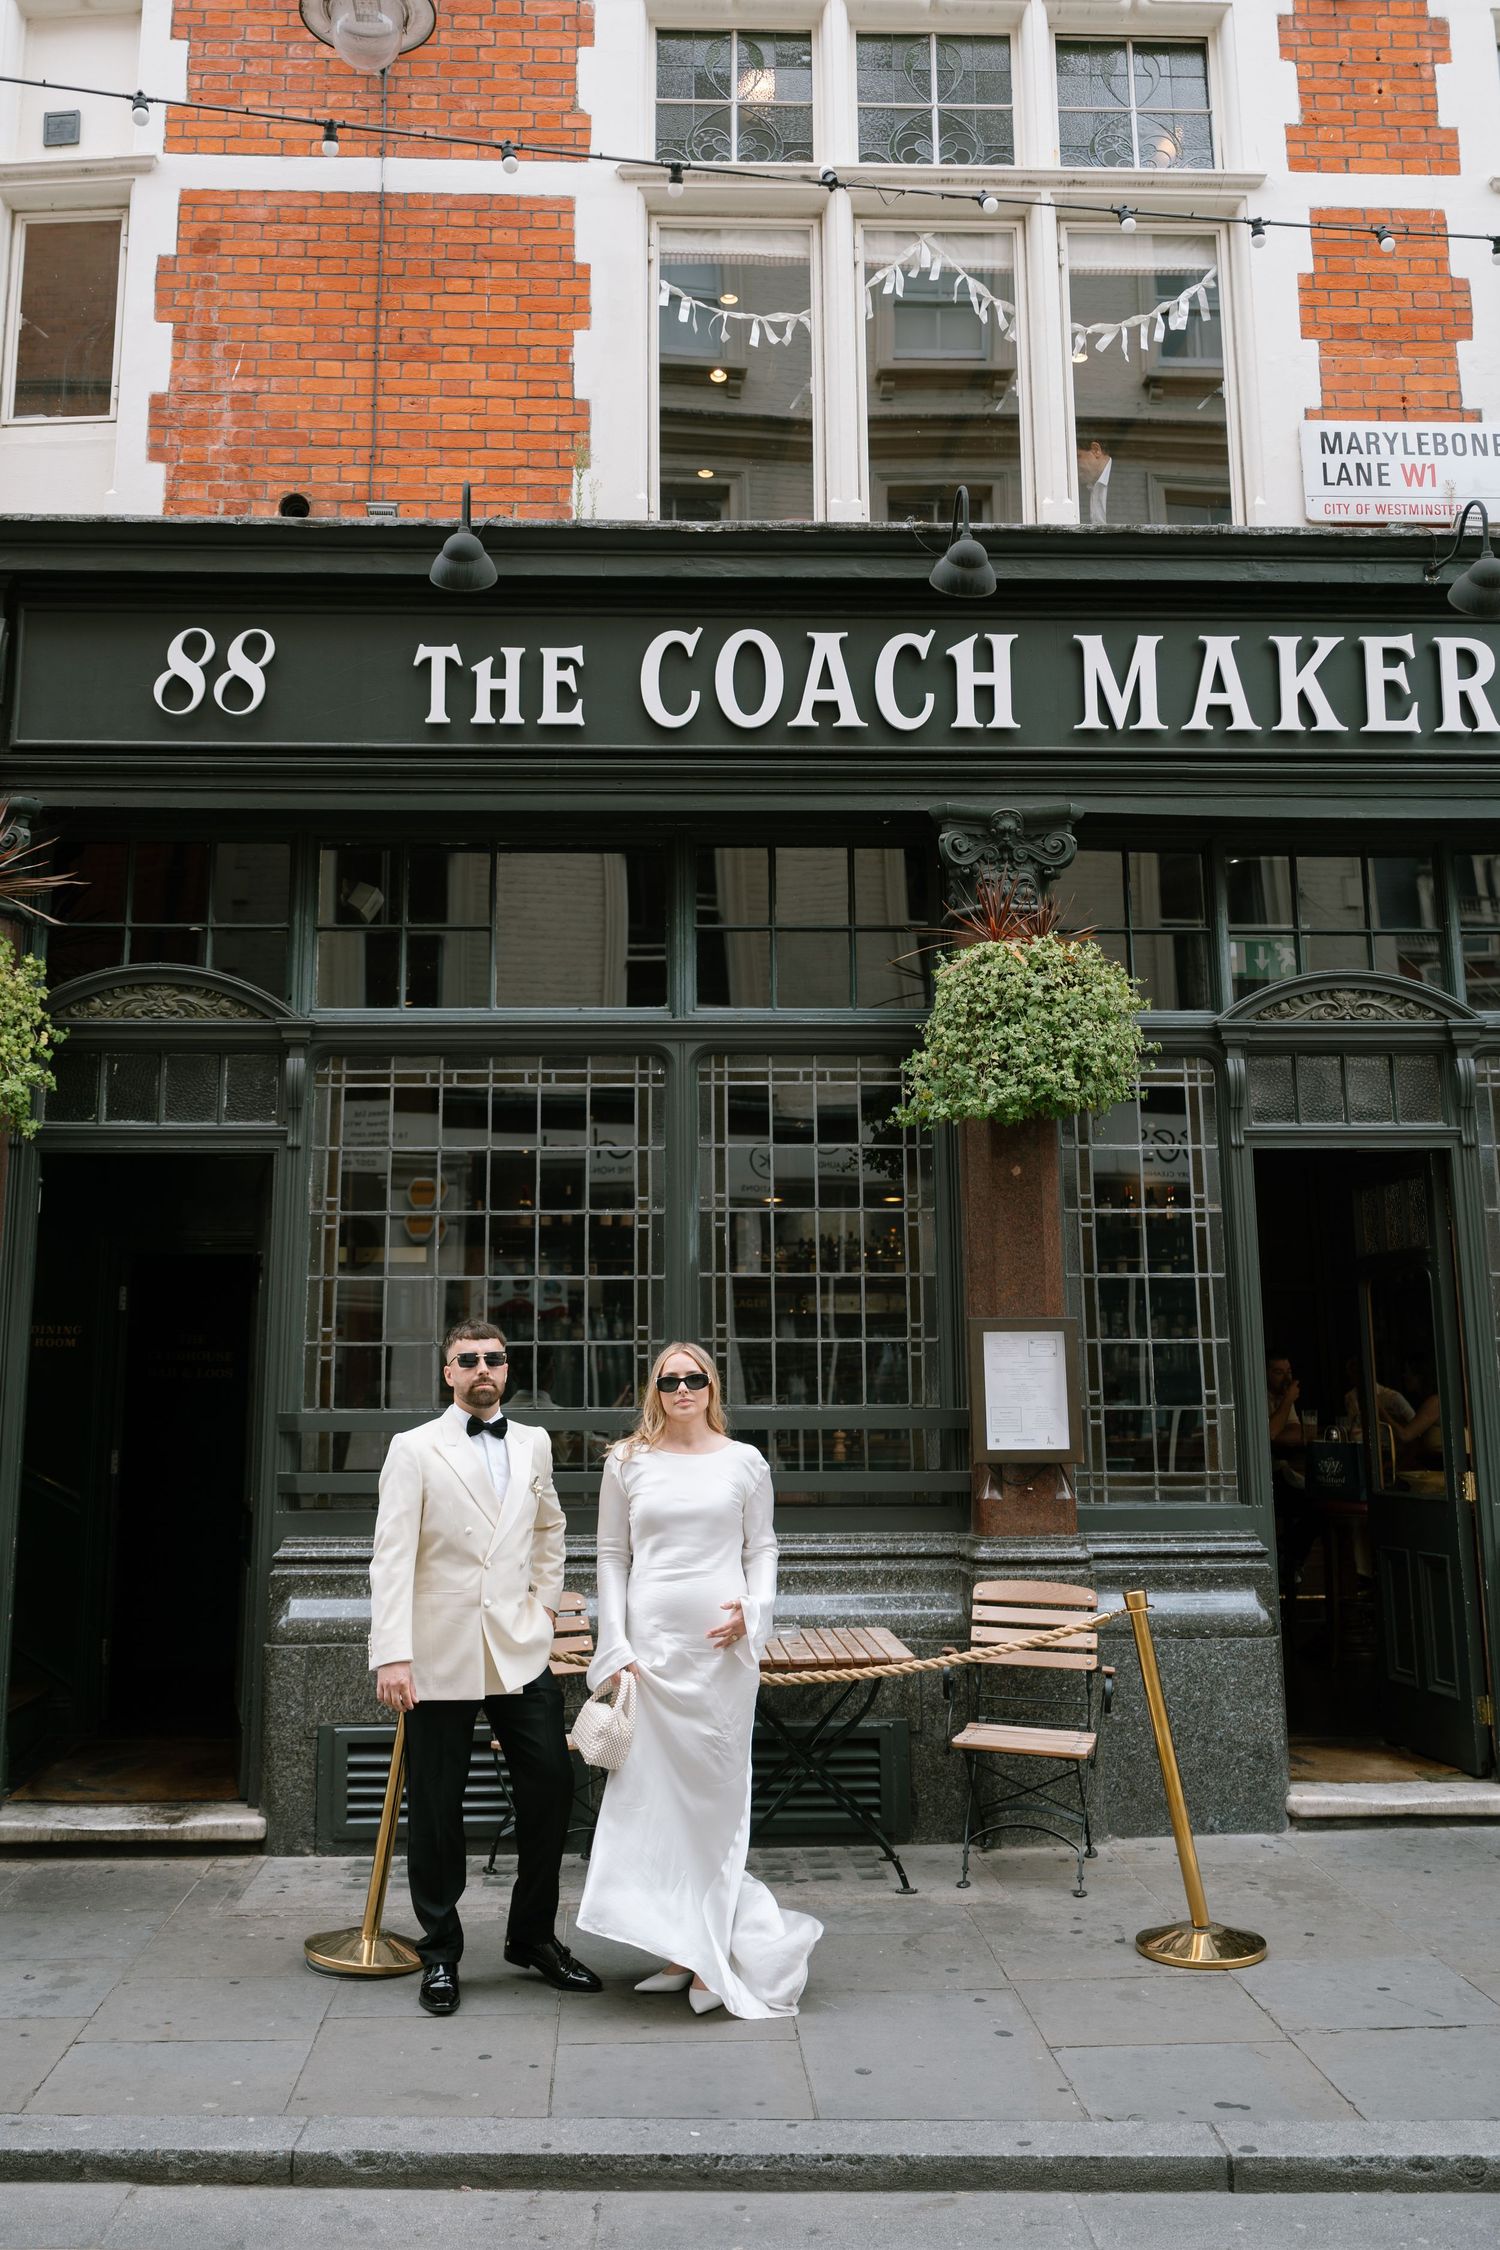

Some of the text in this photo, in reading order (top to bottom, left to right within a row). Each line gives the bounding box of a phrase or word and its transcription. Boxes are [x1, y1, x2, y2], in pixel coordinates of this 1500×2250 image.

[1322, 462, 1437, 488] LANE W1
[1324, 502, 1350, 515] CITY
[1355, 503, 1371, 515] OF
[154, 627, 1500, 737] 88 THE COACH MAKER
[31, 1324, 83, 1335] DINING
[35, 1337, 77, 1348] ROOM
